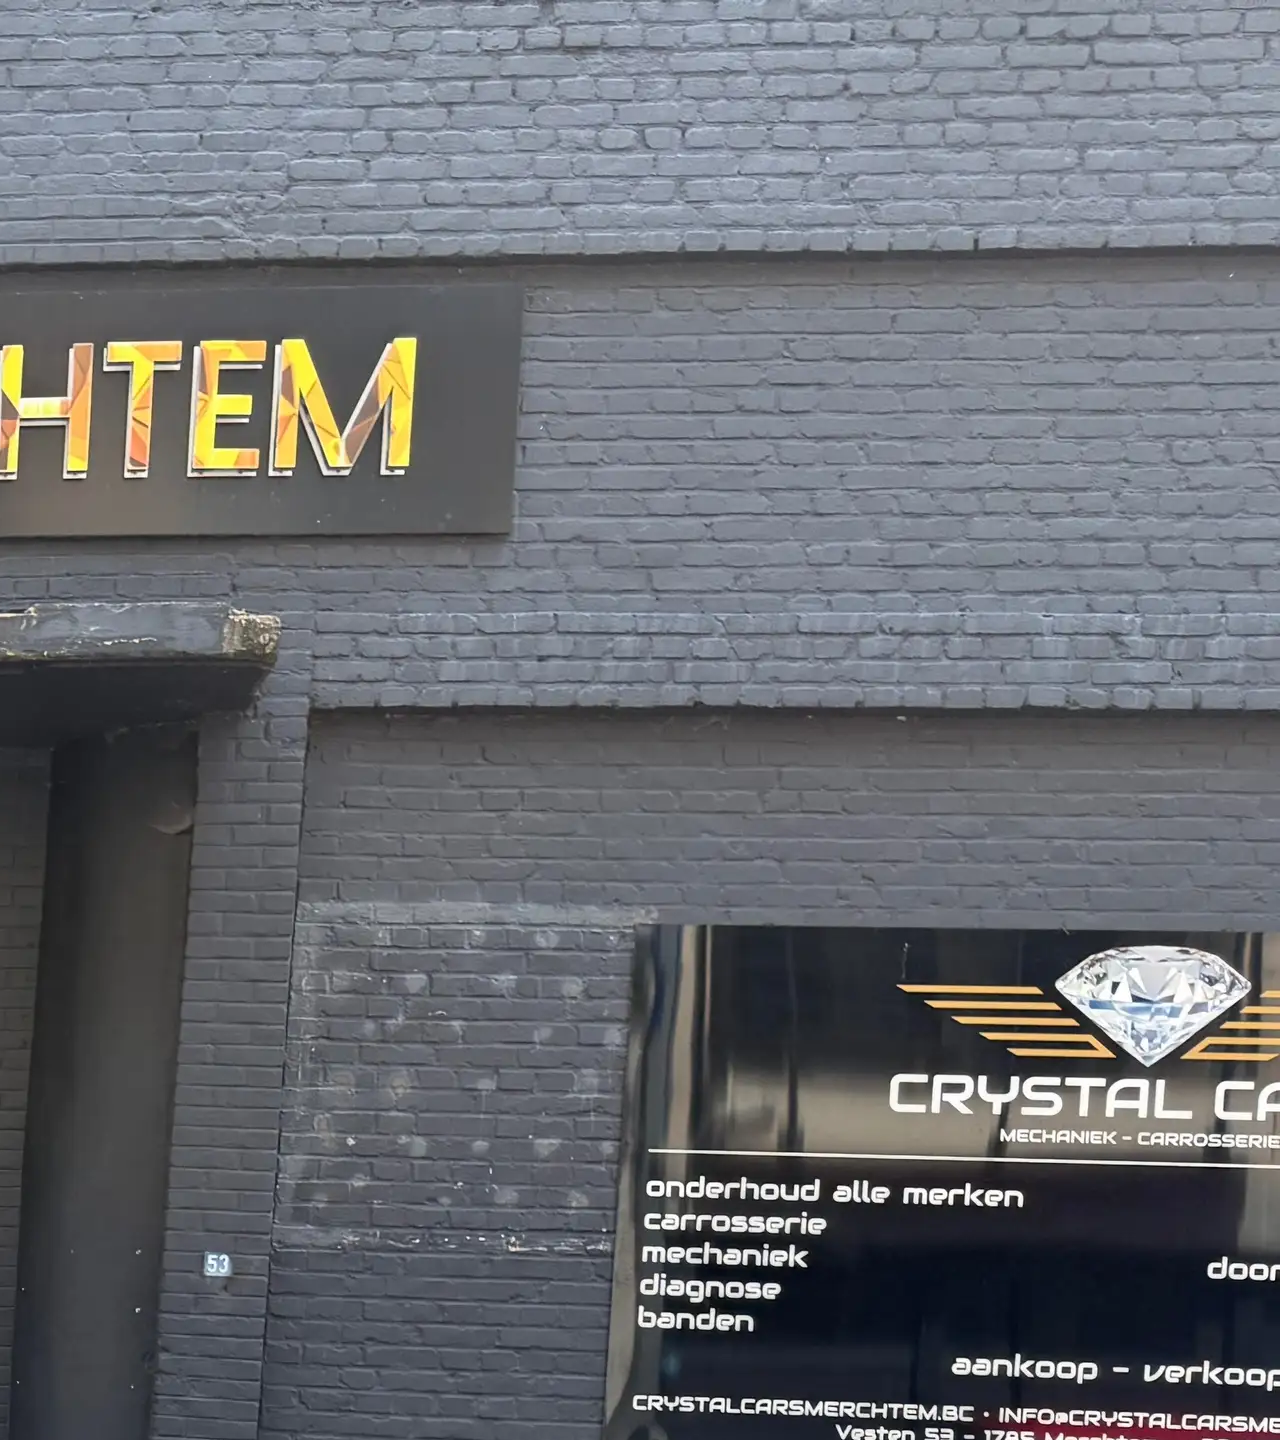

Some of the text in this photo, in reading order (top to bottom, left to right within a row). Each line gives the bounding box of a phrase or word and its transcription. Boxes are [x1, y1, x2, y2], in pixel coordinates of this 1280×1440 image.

[889, 1073, 1193, 1120] CRYSTAL
[1000, 1128, 1117, 1145] MECHANIEK
[1137, 1131, 1280, 1149] CARROSSERIE
[646, 1176, 1024, 1207] onderhoud alle merken
[644, 1212, 827, 1235] carrosserie
[207, 1253, 230, 1274] 53
[642, 1242, 809, 1268] mechaniek
[640, 1273, 781, 1303] diagnose
[638, 1306, 754, 1332] banden
[951, 1353, 1098, 1384] aankoop
[1144, 1360, 1280, 1391] verkoop
